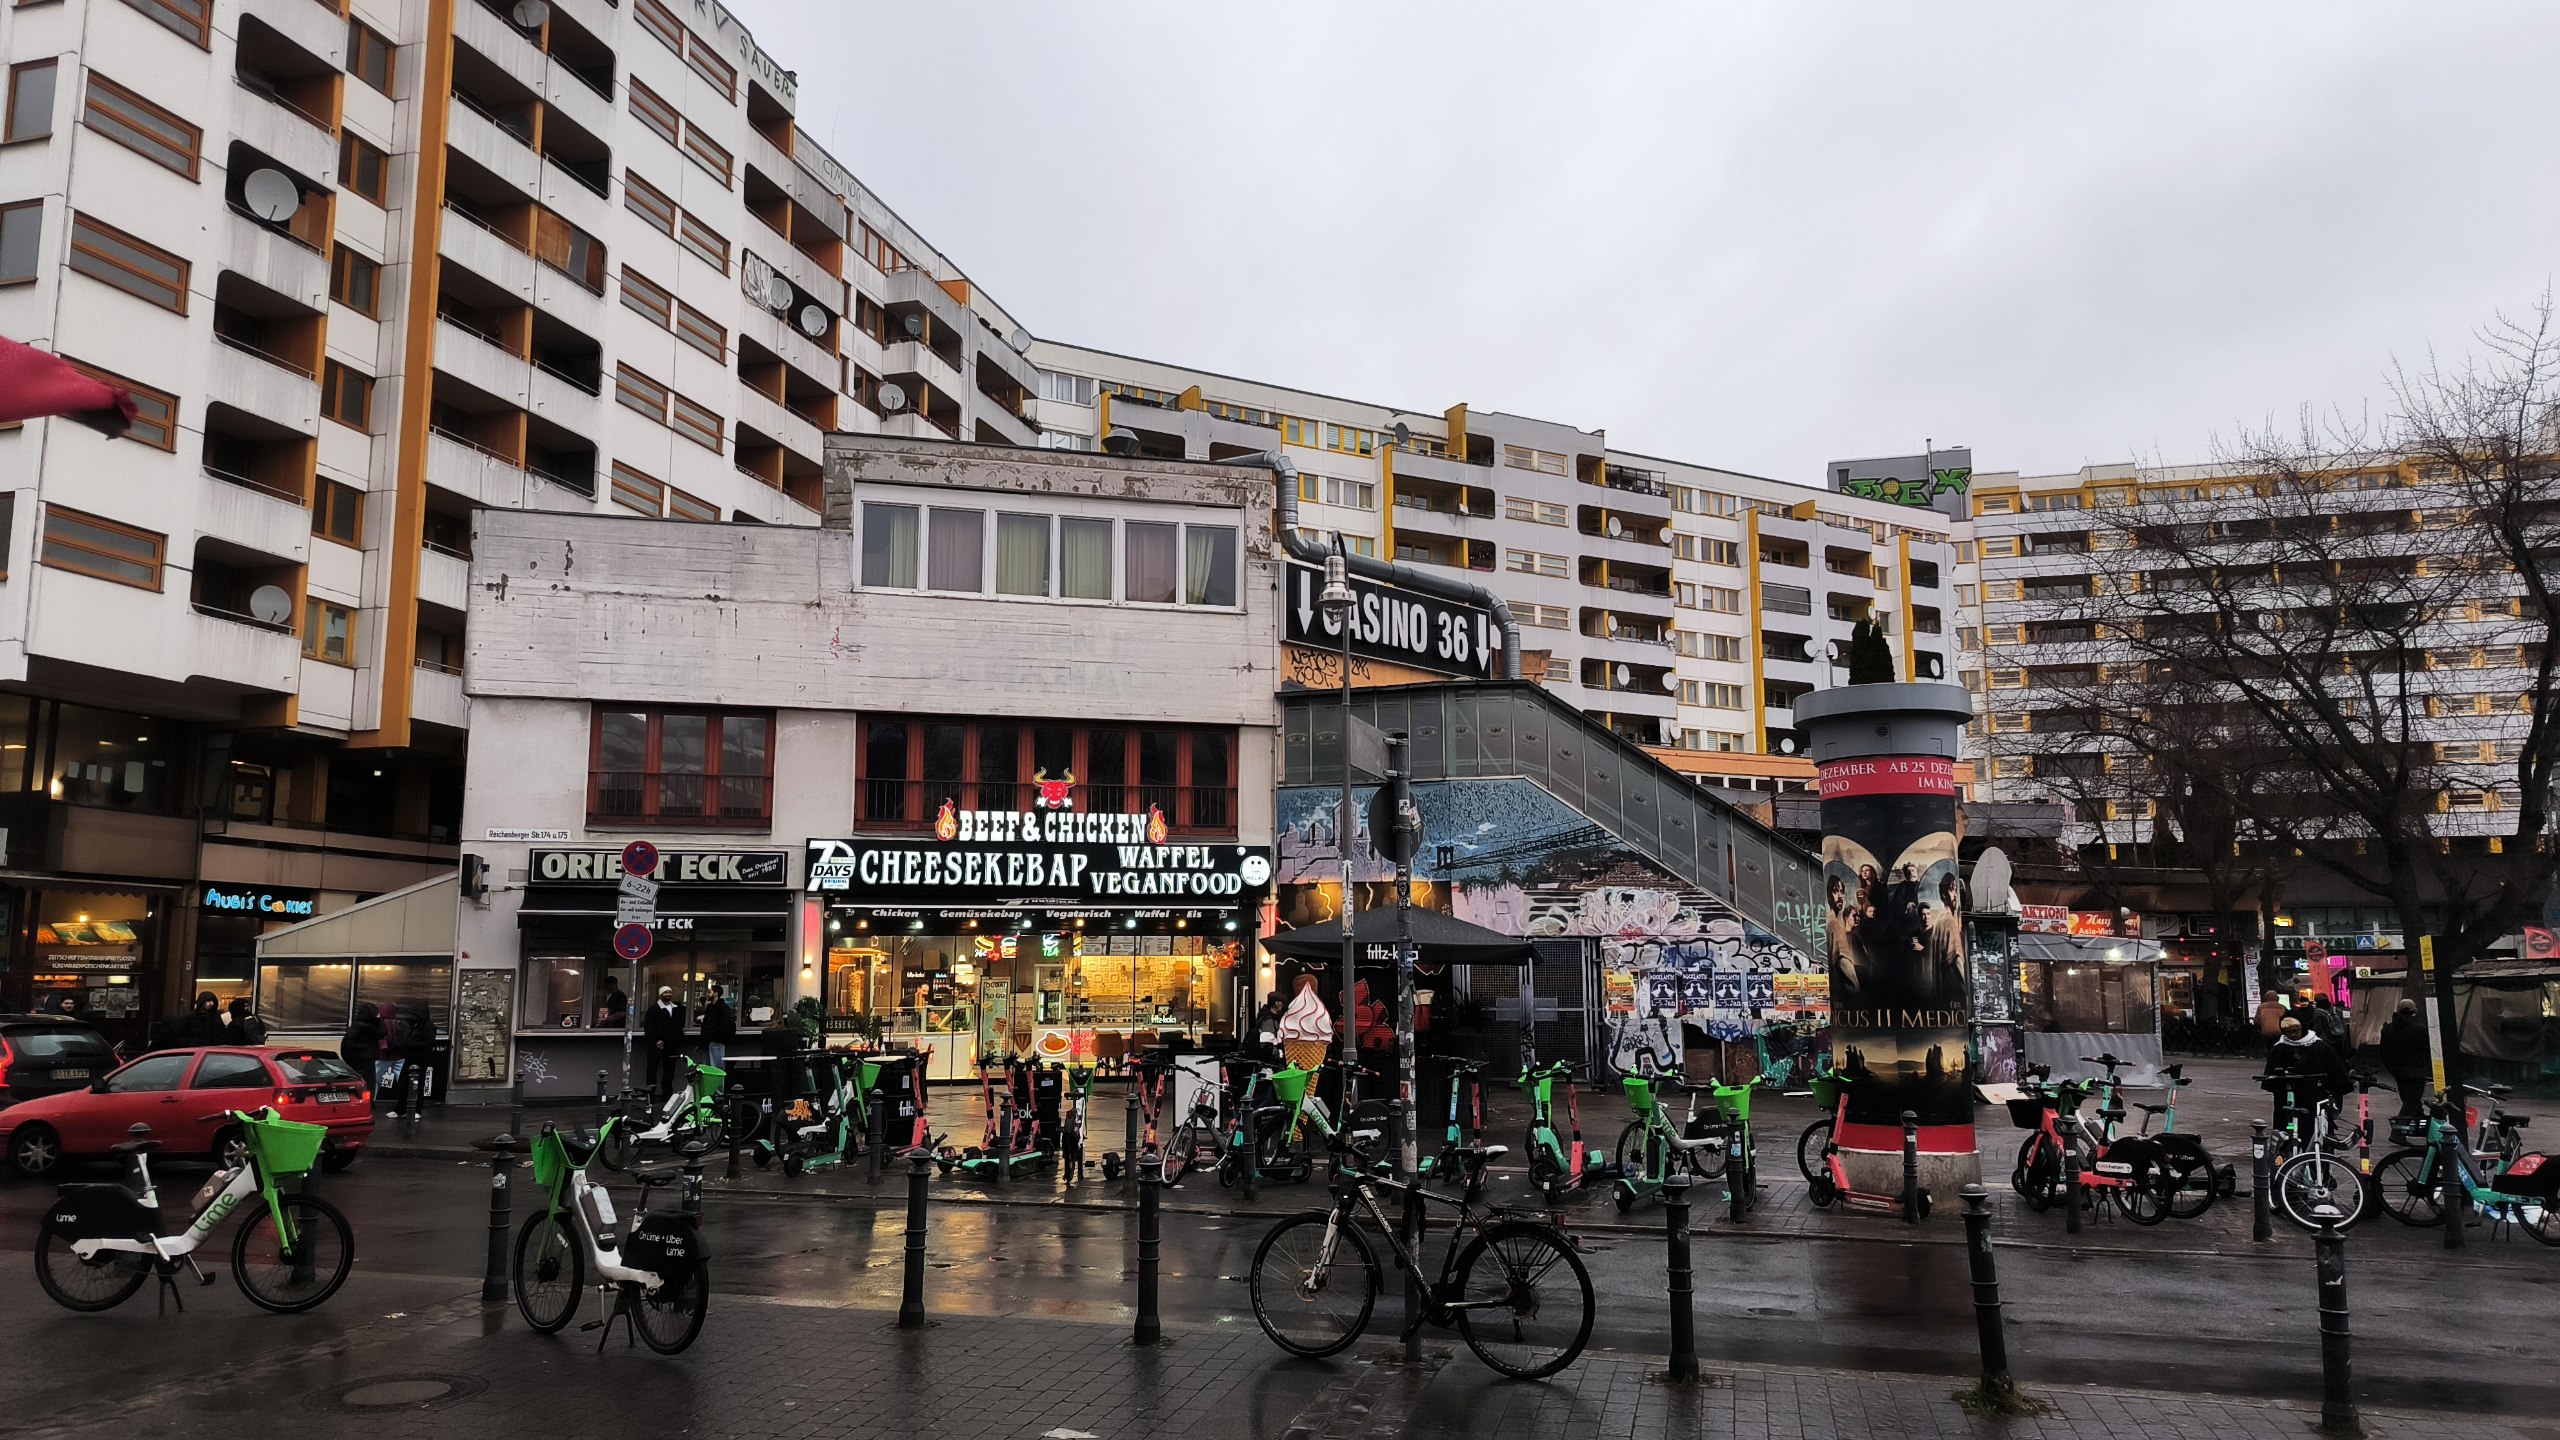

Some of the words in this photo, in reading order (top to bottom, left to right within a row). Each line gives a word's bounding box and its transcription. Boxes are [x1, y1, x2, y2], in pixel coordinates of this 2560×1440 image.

[1438, 611, 1469, 663] 36
[1820, 763, 1877, 780] DEZEMBER
[1888, 762, 1908, 773] AB
[1911, 762, 1927, 773] 25.
[1823, 780, 1849, 794] KINO
[1918, 777, 1934, 788] IM
[489, 830, 530, 840] Reichenberger
[1117, 846, 1215, 869] WAFFEL
[542, 852, 671, 881] ORIET
[680, 854, 743, 881] ECK
[813, 865, 852, 877] DAYS
[860, 850, 1088, 887] CHEESEKEBAP
[1090, 872, 1242, 895] VEGANFOOD
[872, 909, 919, 918] Chicken
[939, 909, 1023, 921] Gemüsekebap
[1046, 909, 1112, 919] Vegatarisch
[1134, 910, 1170, 918] Waffel
[667, 918, 693, 929] ECK
[56, 1213, 77, 1223] Lime
[193, 1192, 237, 1233] Lime
[647, 1232, 660, 1242] Lime
[665, 1234, 683, 1244] Uber
[666, 1246, 686, 1257] Lime
